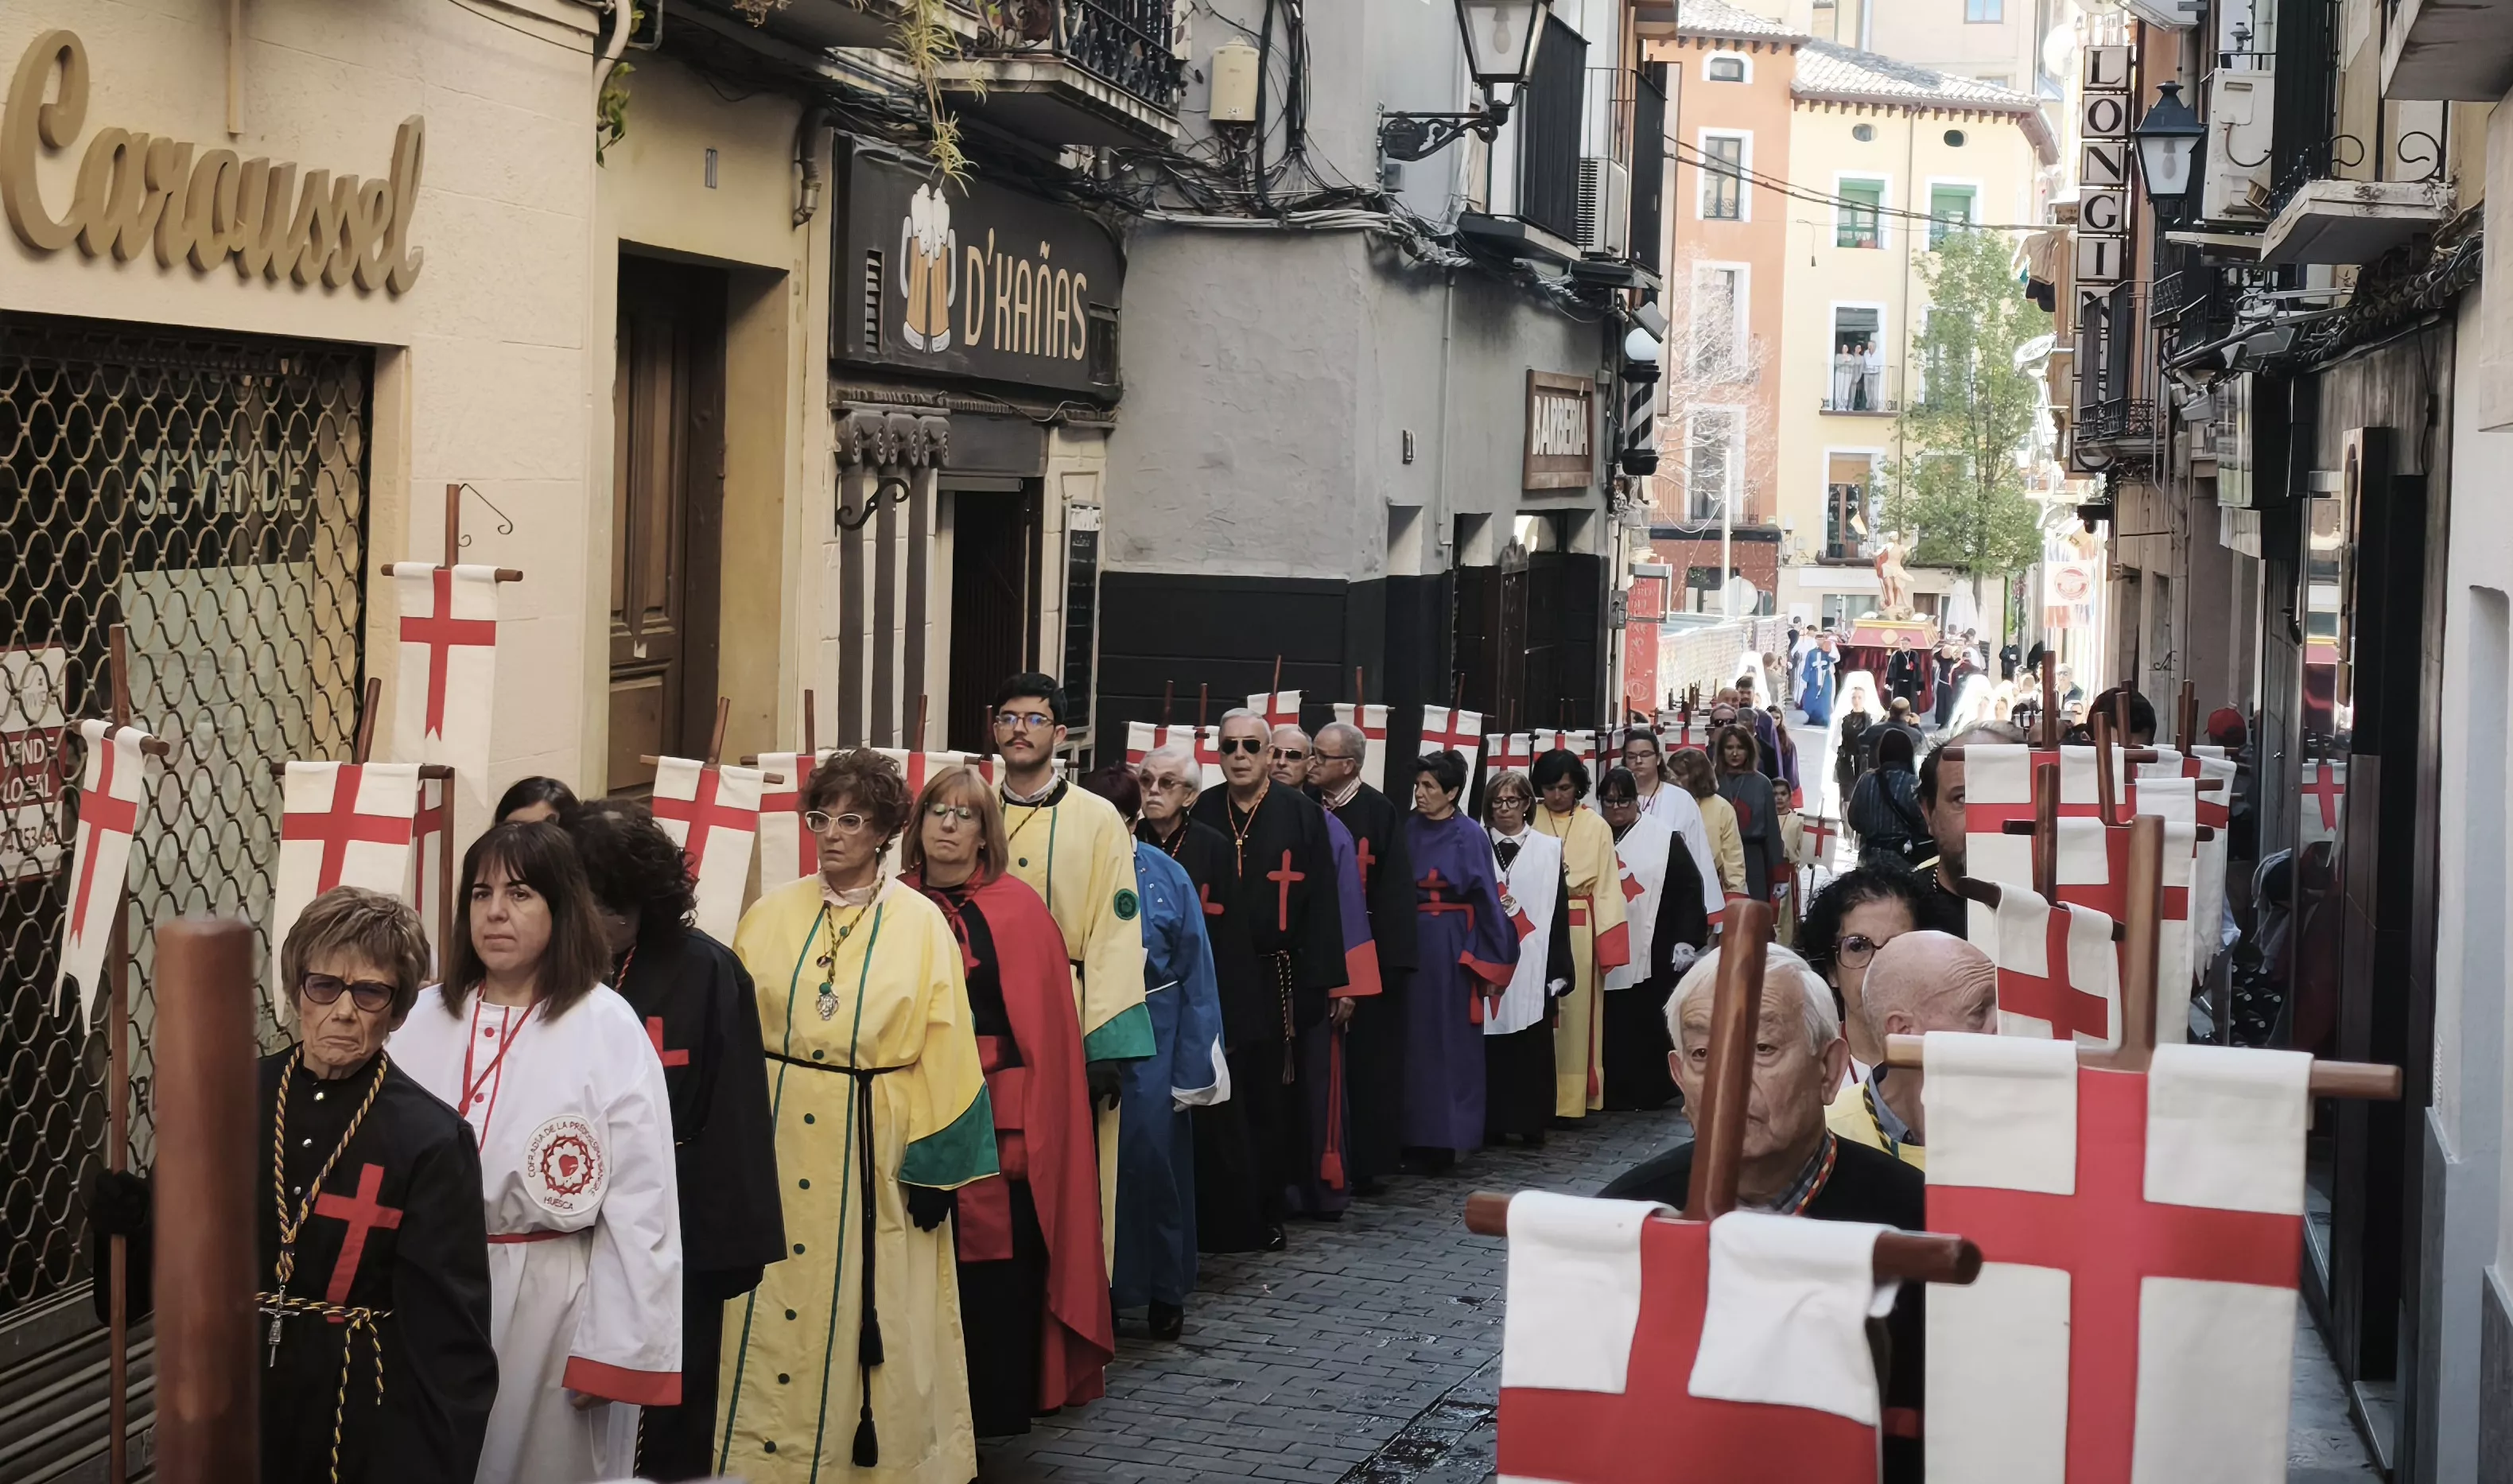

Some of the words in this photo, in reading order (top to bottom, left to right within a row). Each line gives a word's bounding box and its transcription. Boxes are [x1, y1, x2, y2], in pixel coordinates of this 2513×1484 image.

[2, 29, 426, 296] Caroussel
[965, 227, 1087, 360] D'KAÑAS
[138, 449, 179, 516] SE
[190, 449, 302, 514] VENDE
[544, 1125, 556, 1136] DE
[544, 1196, 573, 1209] HUESCA
